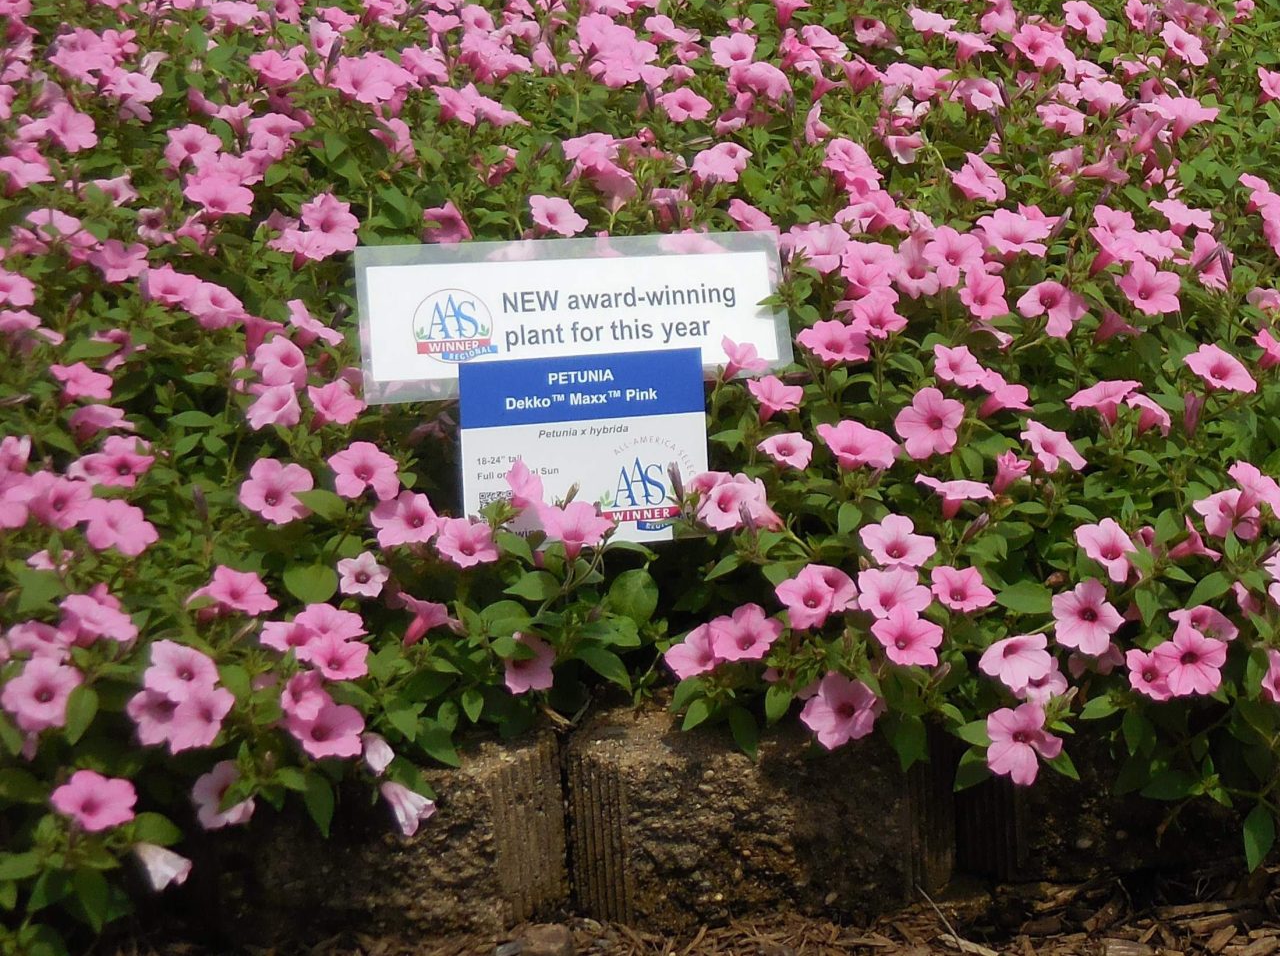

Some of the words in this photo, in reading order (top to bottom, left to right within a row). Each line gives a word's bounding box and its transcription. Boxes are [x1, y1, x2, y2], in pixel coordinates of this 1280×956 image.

[502, 290, 558, 313] NEW
[567, 283, 736, 309] award-winning
[427, 294, 479, 340] AAS
[505, 323, 564, 352] plant
[571, 321, 604, 343] for
[610, 319, 654, 341] this
[661, 319, 711, 343] year
[428, 340, 479, 353] WINNER
[449, 346, 492, 361] REGIONAL
[548, 369, 614, 385] PETUNIA
[626, 388, 658, 402] Pink
[538, 428, 578, 439] Petunia
[589, 425, 629, 437] hybrida
[614, 435, 676, 456] ALL-AMERICA
[478, 471, 494, 480] Full
[541, 467, 559, 475] Sun
[611, 457, 666, 508] AAS
[613, 509, 670, 521] WINNER
